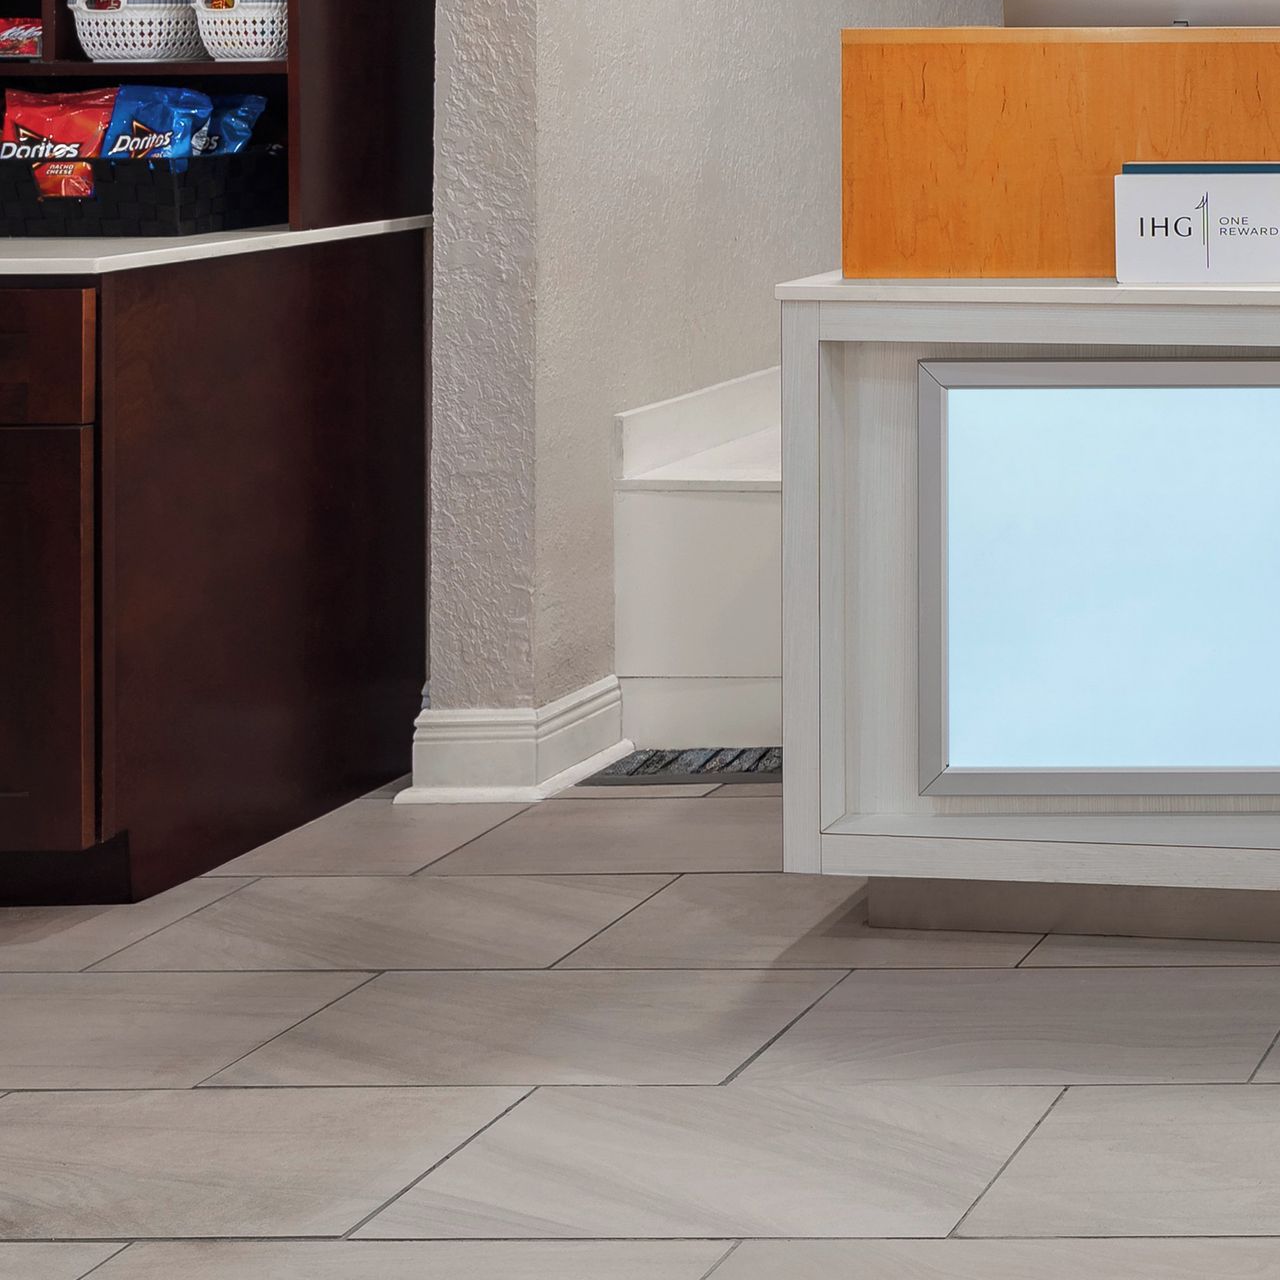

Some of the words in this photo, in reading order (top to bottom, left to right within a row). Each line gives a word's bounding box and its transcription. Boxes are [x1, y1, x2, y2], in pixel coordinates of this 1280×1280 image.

[0, 136, 80, 159] Doritos
[109, 130, 173, 154] Doritos
[1139, 216, 1192, 237] IHG
[1219, 216, 1249, 226] ONE
